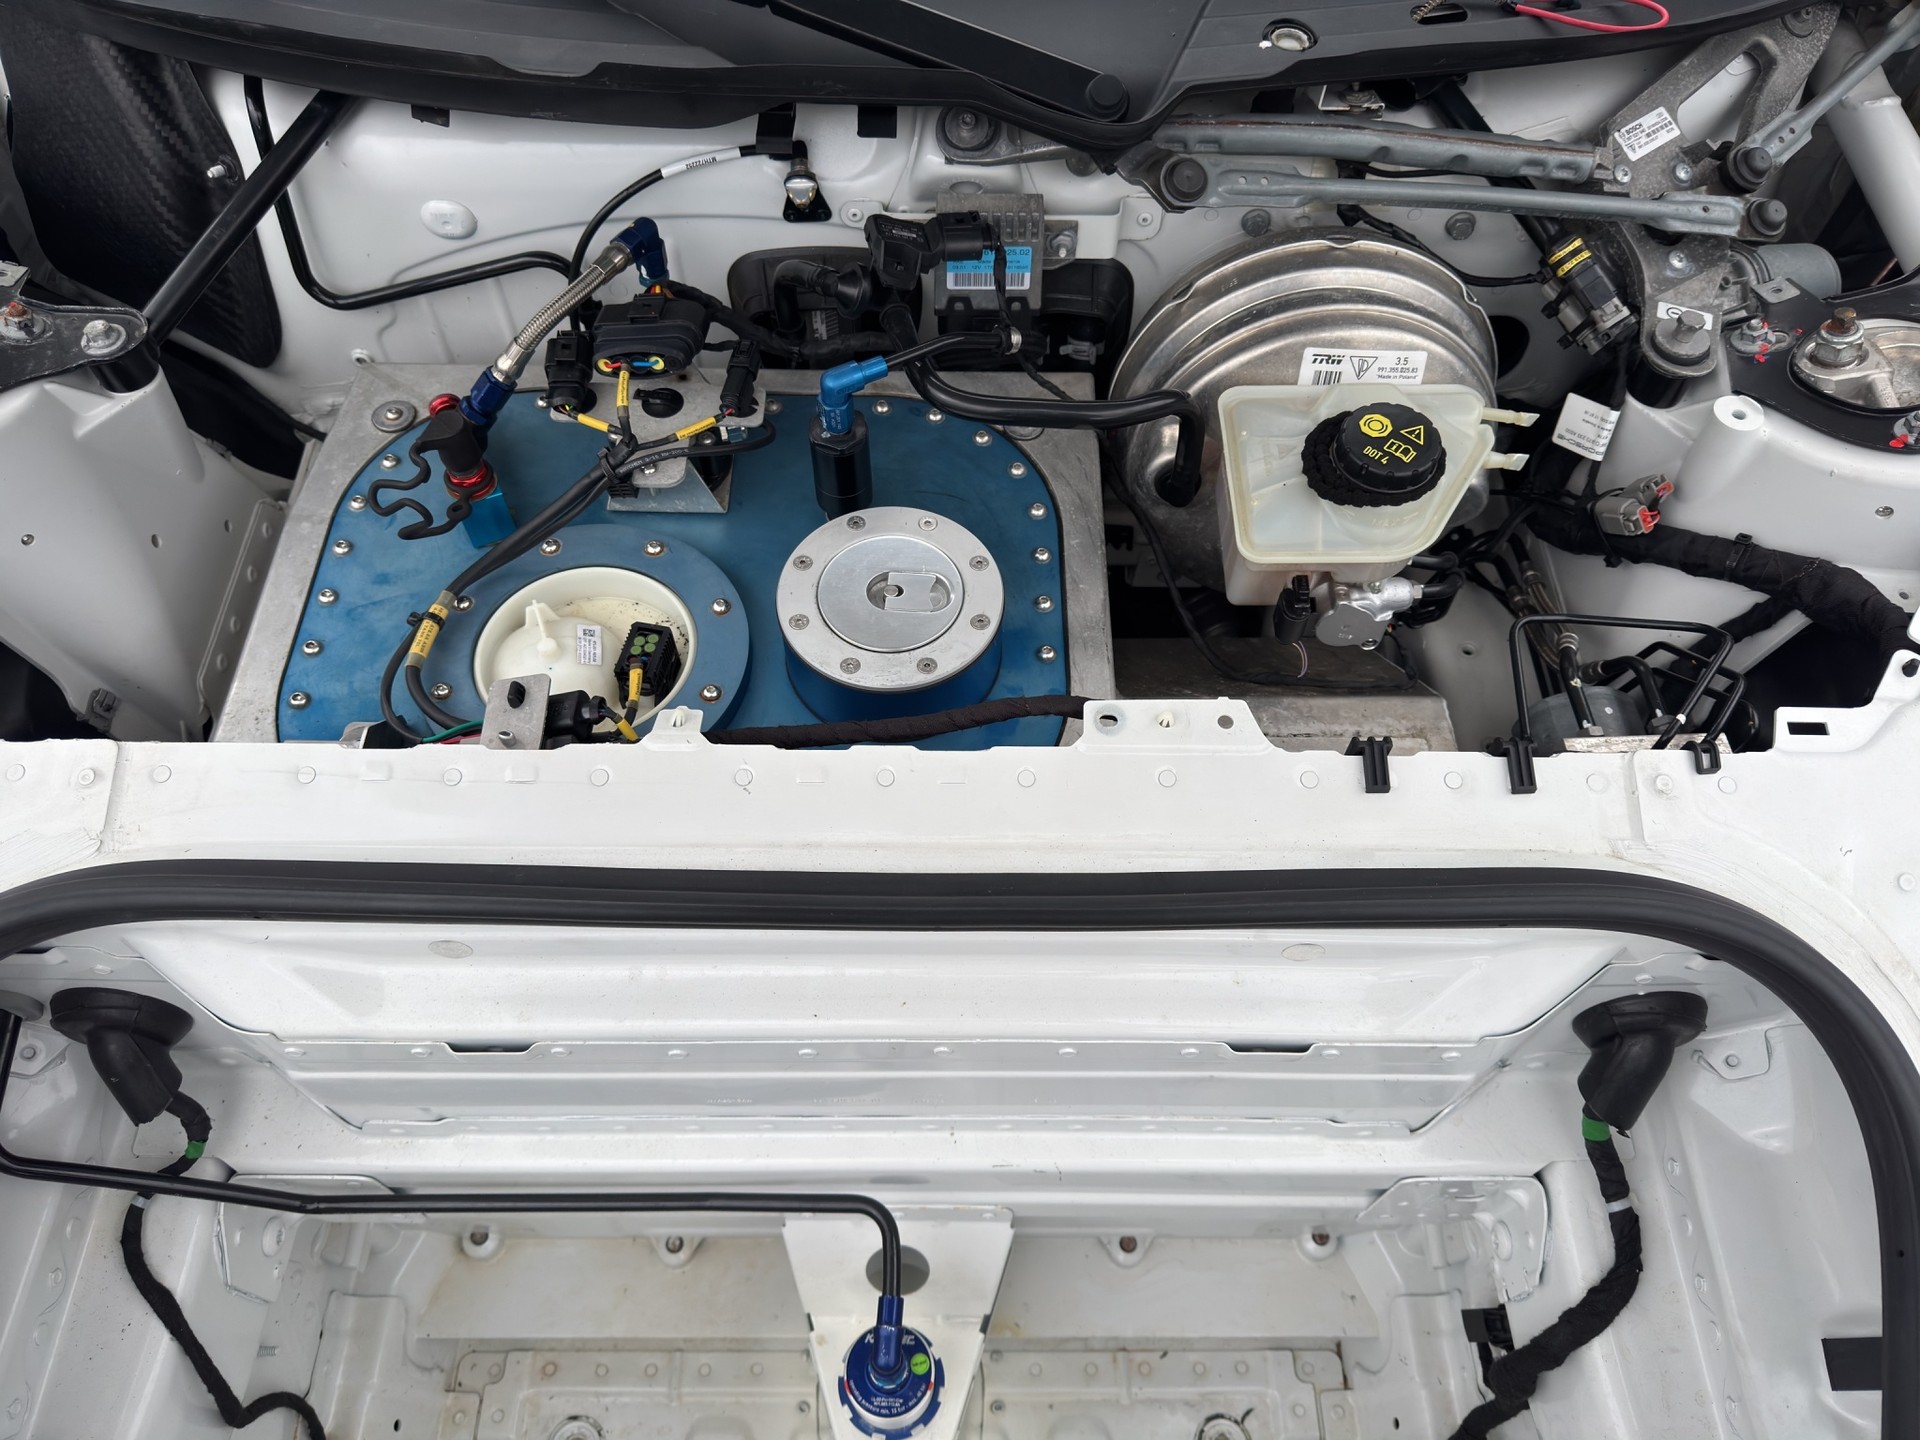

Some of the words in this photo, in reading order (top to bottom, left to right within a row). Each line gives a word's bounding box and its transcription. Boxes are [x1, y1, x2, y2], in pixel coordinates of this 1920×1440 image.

[1625, 122, 1644, 135] BOSCH
[1312, 353, 1345, 365] TRW
[1395, 357, 1409, 366] 3.5
[1557, 433, 1604, 455] PORSCHE
[1363, 446, 1383, 460] DOT
[1381, 456, 1390, 465] 4
